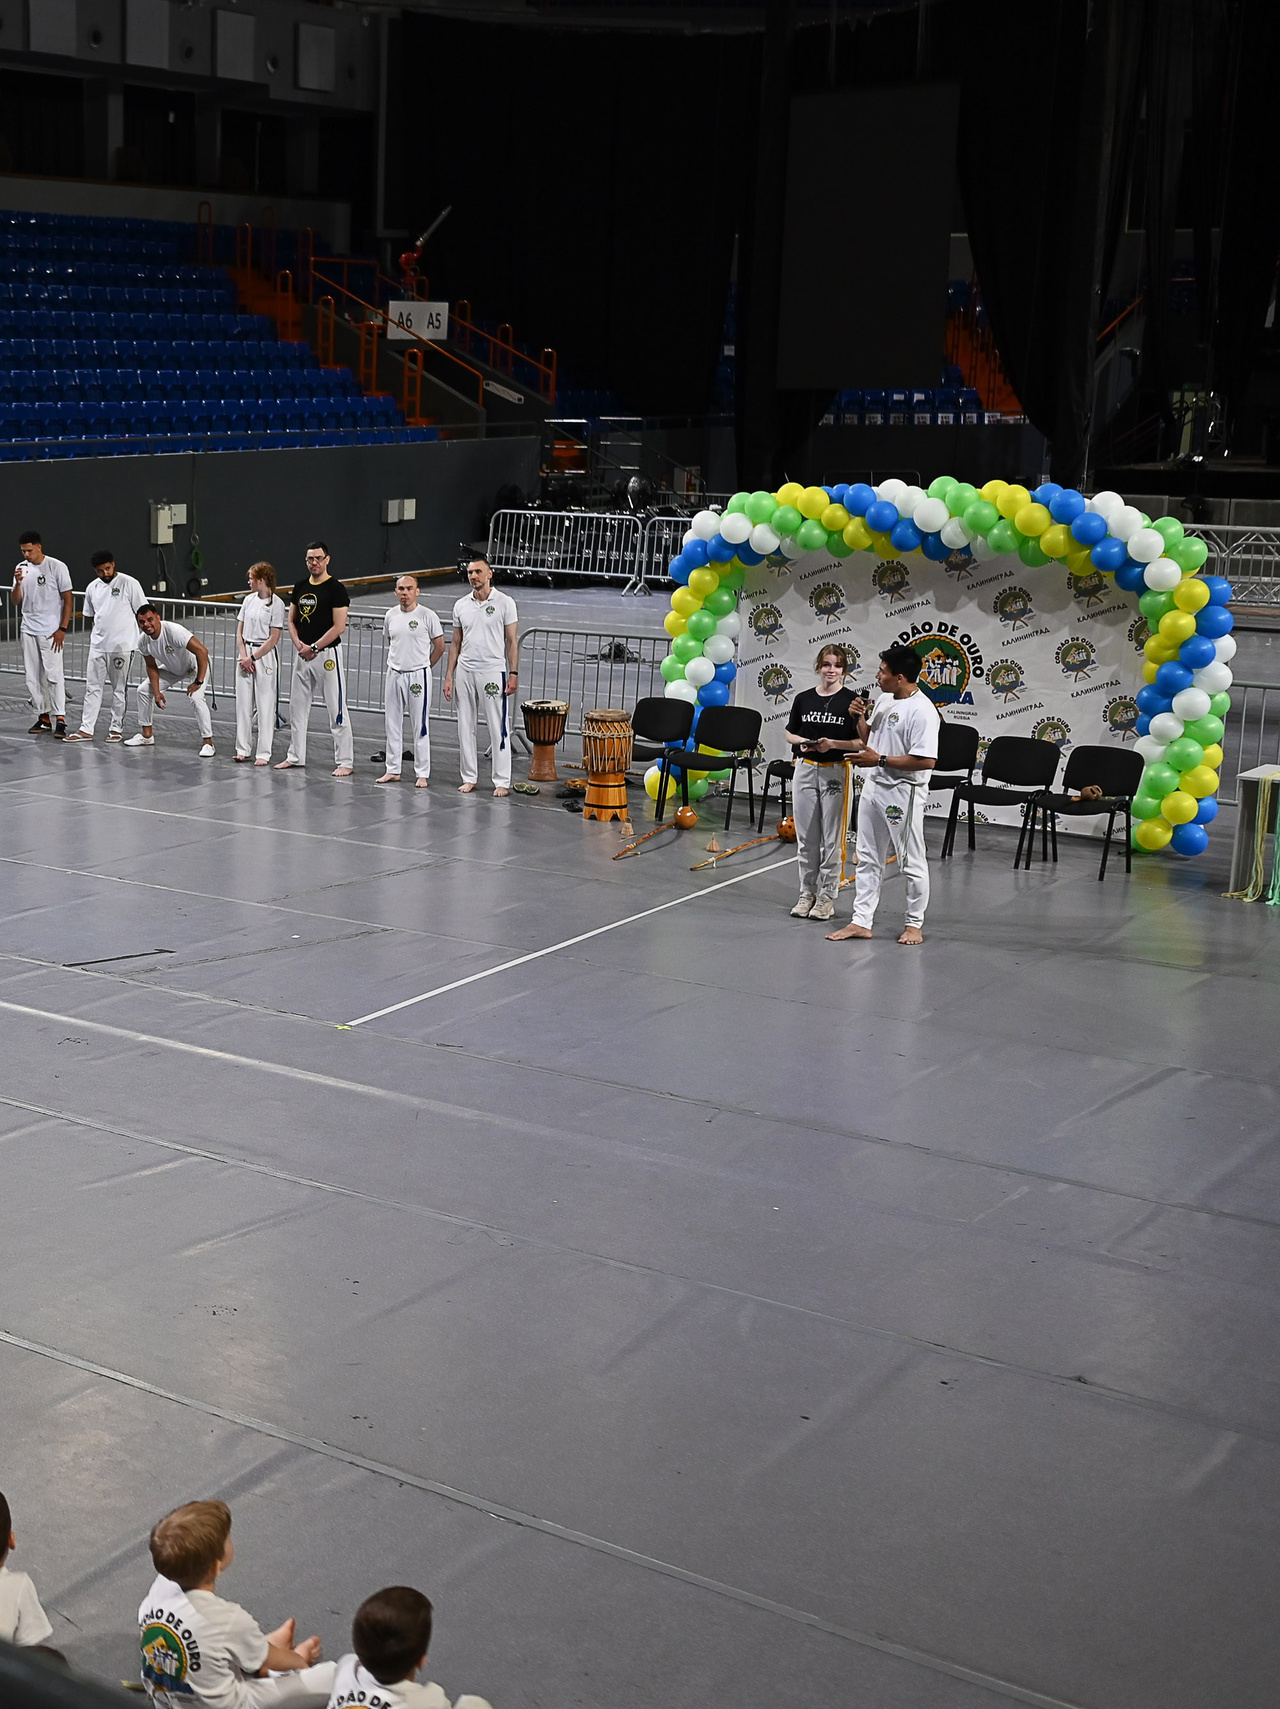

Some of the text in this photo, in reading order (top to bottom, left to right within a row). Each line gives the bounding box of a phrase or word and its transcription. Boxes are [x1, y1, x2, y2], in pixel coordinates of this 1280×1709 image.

[427, 312, 442, 330] A5
[736, 652, 774, 669] АЛИНИНГРАД
[937, 621, 959, 638] DE
[959, 633, 985, 679] OURO
[165, 1611, 183, 1630] DE
[181, 1629, 201, 1672] OURO
